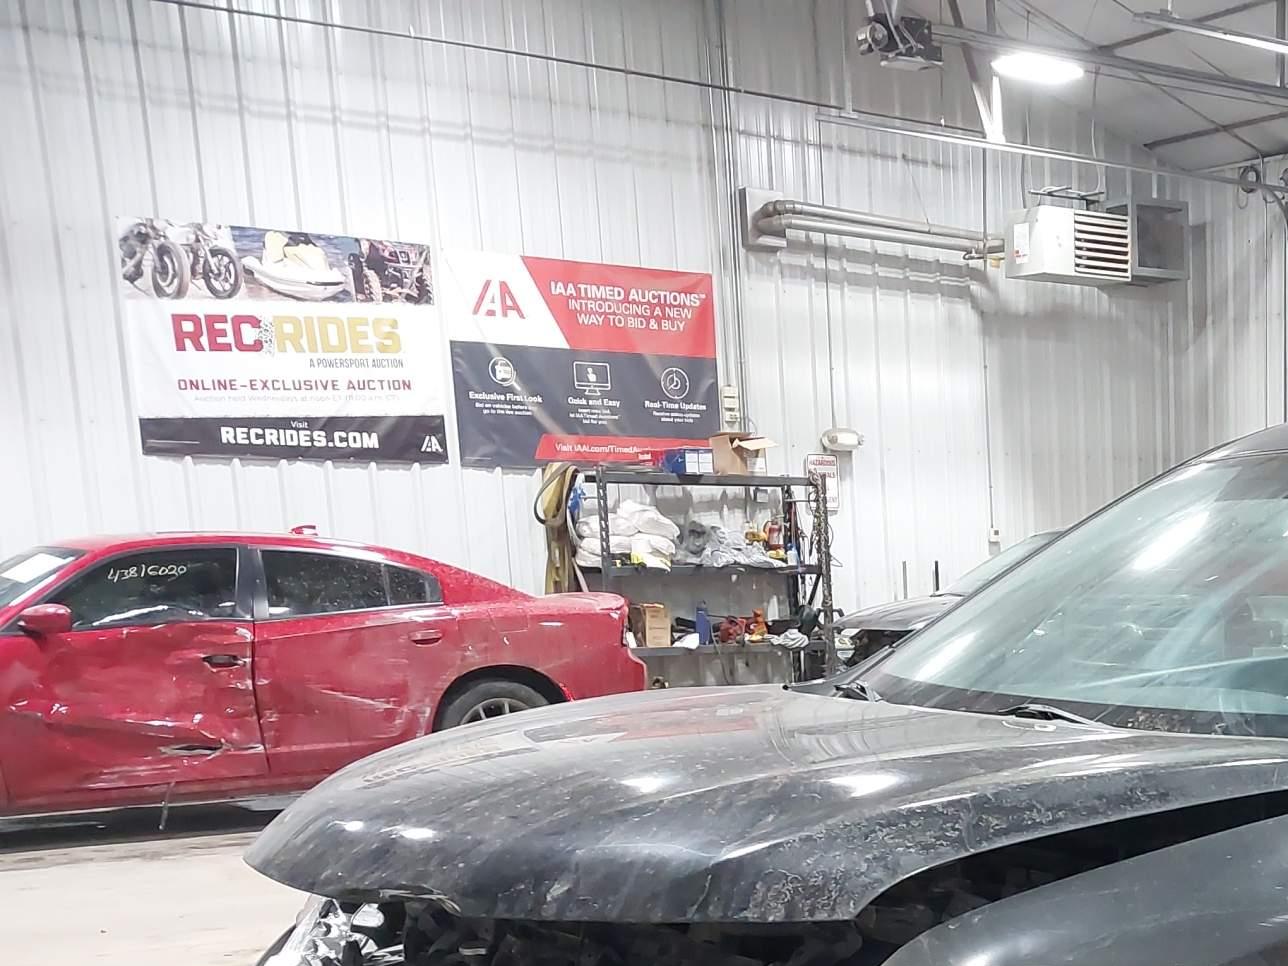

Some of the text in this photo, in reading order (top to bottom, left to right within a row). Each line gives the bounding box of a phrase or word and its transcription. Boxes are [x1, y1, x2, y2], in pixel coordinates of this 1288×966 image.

[550, 280, 577, 297] IAA
[578, 284, 625, 300] TIMED
[568, 299, 692, 319] INTRODUCING A NEW
[577, 313, 685, 331] WAY TO BID & BUY
[171, 313, 402, 354] REC RIDES
[309, 358, 404, 369] A POWERSPORT AUCTION
[177, 379, 412, 391] ONLINE-EXCLUSIVE AUCTION
[468, 391, 505, 401] Exclusive
[567, 397, 621, 408] Quick and Easy
[644, 401, 707, 411] Real-Time Updates
[290, 420, 308, 429] Visit
[220, 426, 379, 449] RECRIDES.COM
[555, 443, 573, 452] Visit
[107, 563, 187, 583] 43816020
